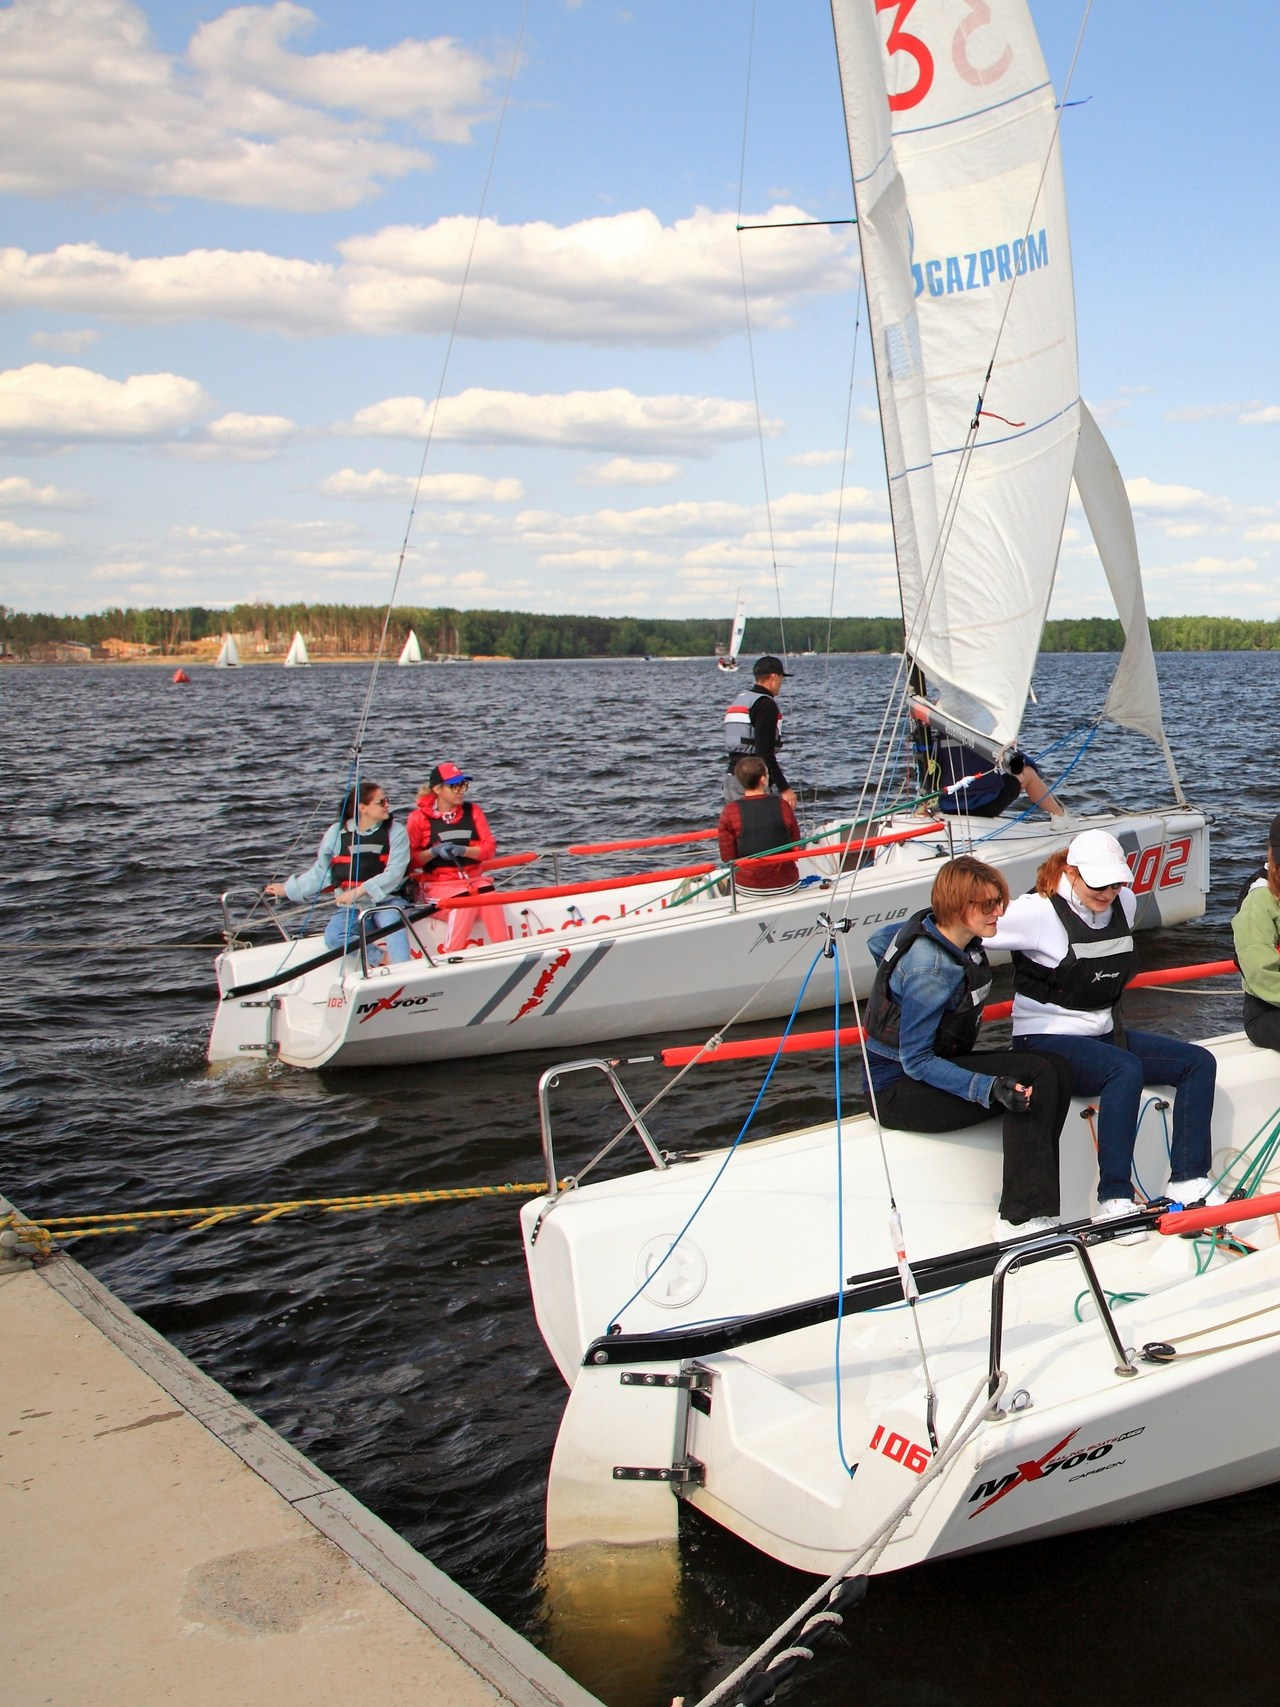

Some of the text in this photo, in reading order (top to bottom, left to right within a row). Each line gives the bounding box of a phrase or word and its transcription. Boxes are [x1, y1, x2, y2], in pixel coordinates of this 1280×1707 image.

[875, 0, 935, 112] 3
[925, 229, 1049, 297] GAZPROM
[863, 907, 909, 926] CLUB
[327, 997, 343, 1008] 102
[356, 985, 428, 1024] MX700
[869, 1424, 932, 1475] 106
[1068, 1459, 1127, 1483] CARBON
[967, 1426, 1114, 1520] MX700
